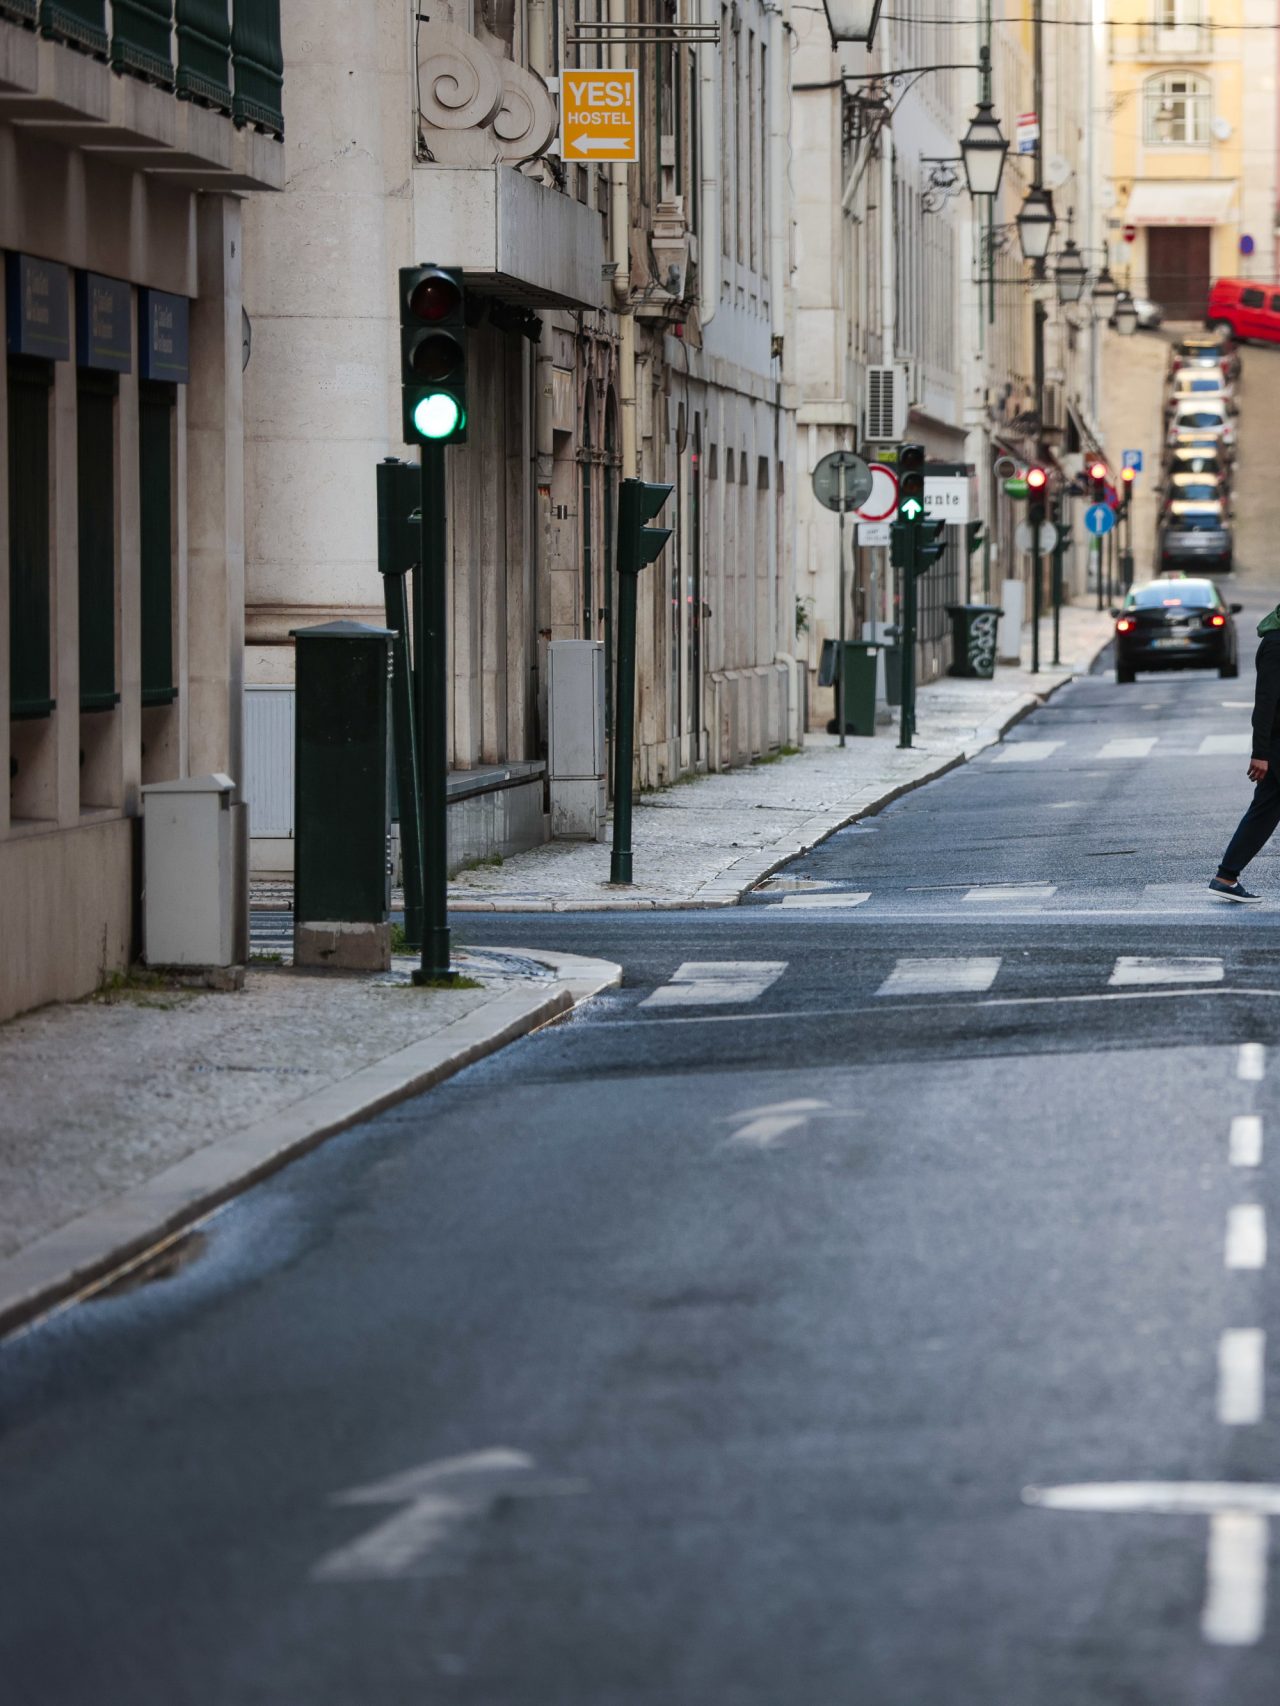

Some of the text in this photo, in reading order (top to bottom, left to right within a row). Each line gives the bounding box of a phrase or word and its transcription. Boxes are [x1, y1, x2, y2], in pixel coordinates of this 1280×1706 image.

[568, 81, 631, 107] YES!
[568, 112, 631, 125] HOSTEL
[924, 492, 960, 505] ante
